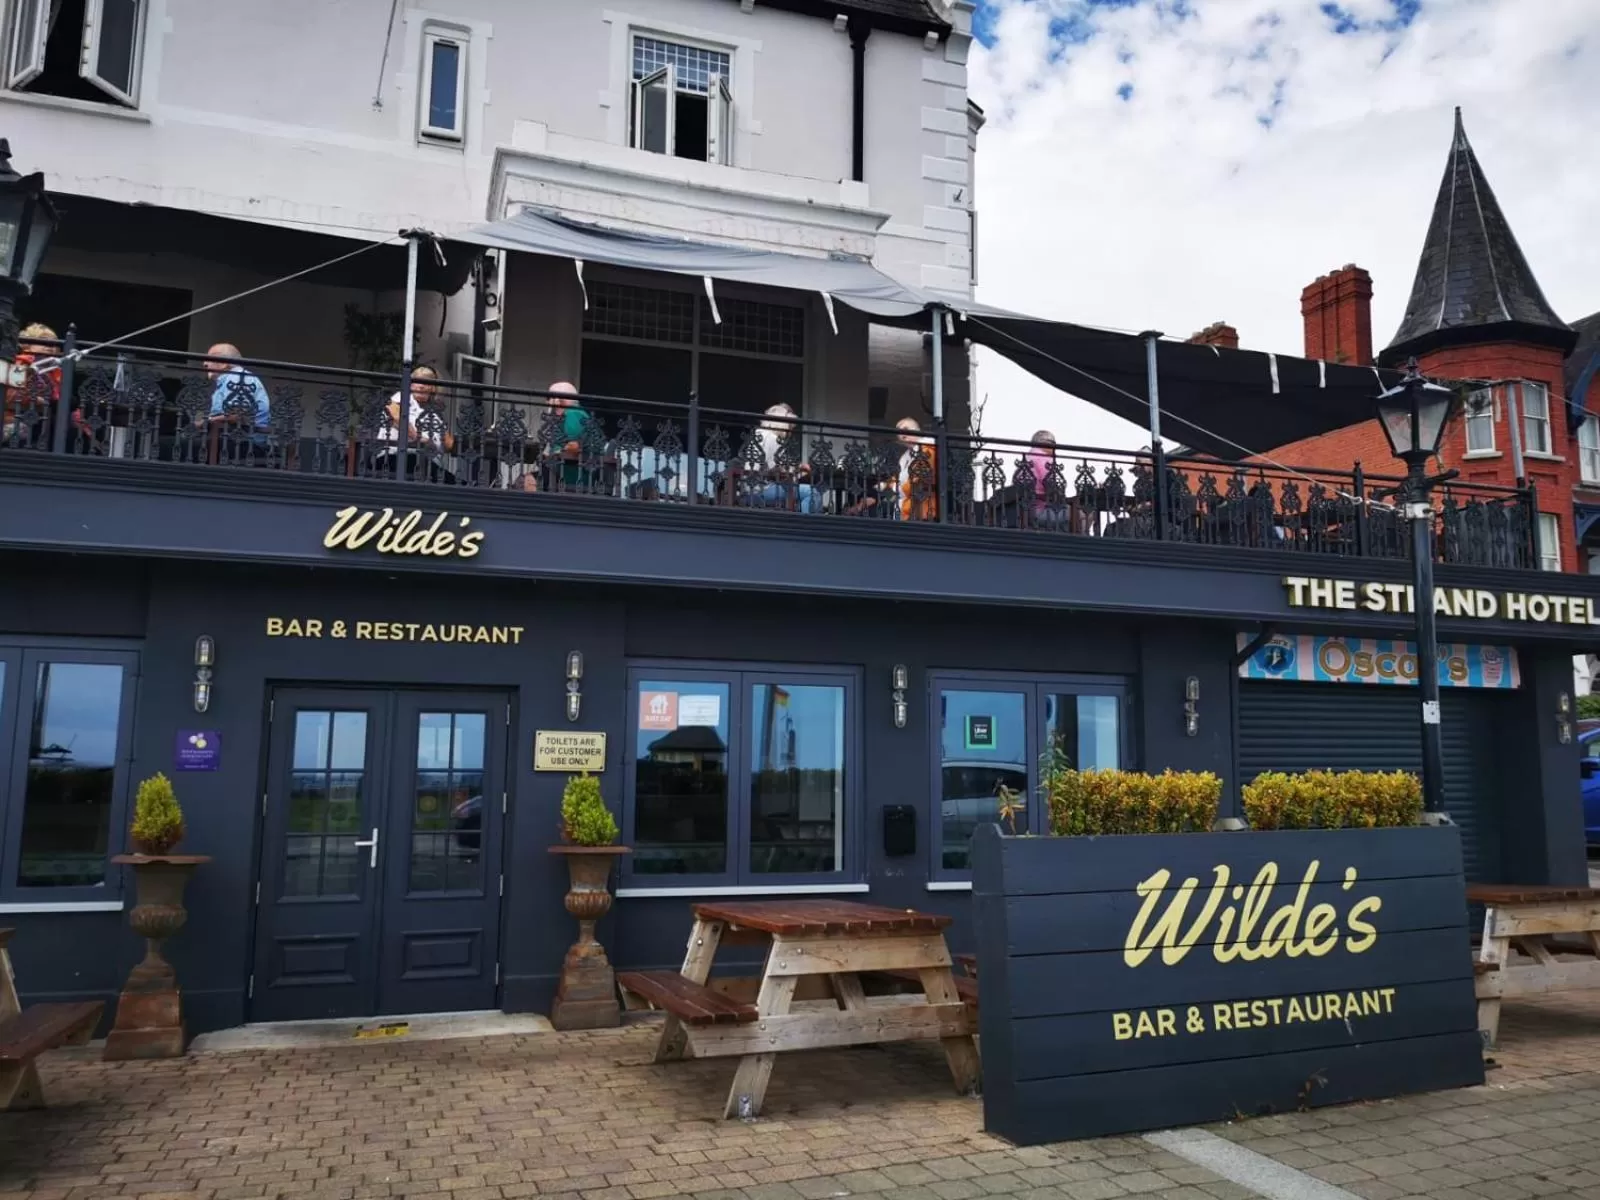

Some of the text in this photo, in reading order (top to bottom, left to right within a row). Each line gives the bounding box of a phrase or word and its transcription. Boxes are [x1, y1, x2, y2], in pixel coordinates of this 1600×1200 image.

[323, 506, 485, 557] Wilde's
[1284, 576, 1356, 609] THE
[1505, 592, 1600, 625] HOTEL
[266, 617, 524, 644] BAR & RESTAURANT
[1319, 640, 1469, 681] Osca's
[540, 747, 601, 756] FOR CUSTOMER
[546, 737, 596, 746] TOILETS ARE
[551, 757, 589, 766] USE ONLY
[1124, 860, 1381, 967] Wilde's
[1113, 988, 1395, 1040] BAR & RESTAURANT
